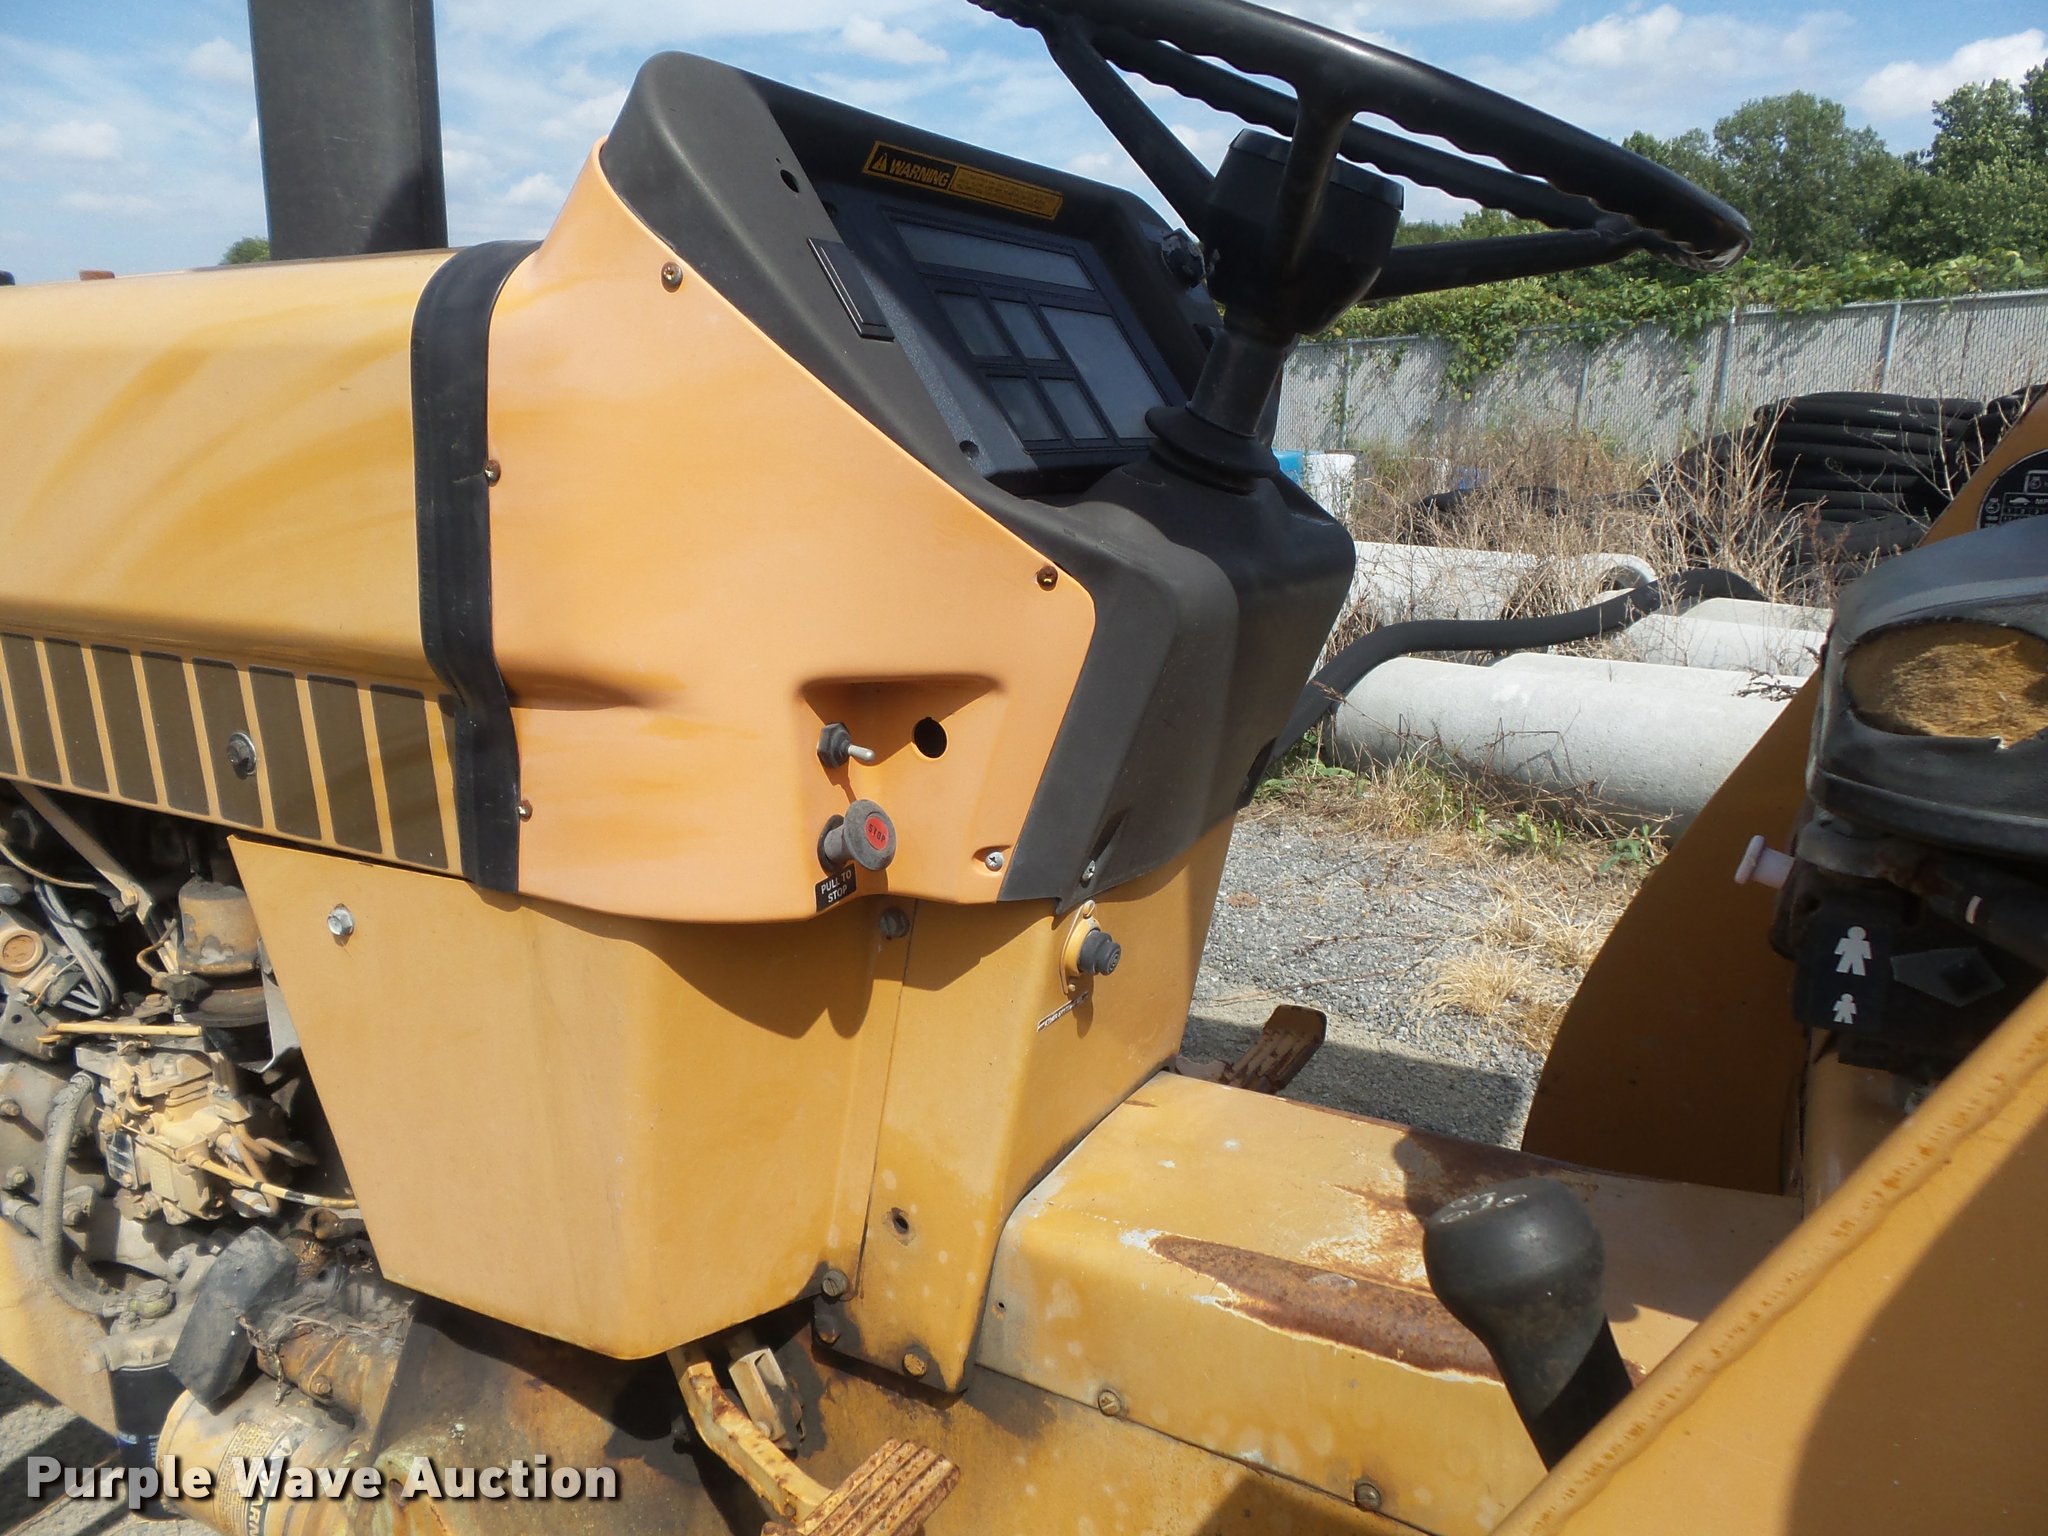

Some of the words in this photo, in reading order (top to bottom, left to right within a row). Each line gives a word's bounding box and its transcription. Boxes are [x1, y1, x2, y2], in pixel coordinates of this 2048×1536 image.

[890, 158, 950, 187] WARNING
[868, 823, 886, 842] STOP
[820, 877, 839, 895] PULL
[841, 869, 852, 882] TO
[827, 884, 848, 903] STOP
